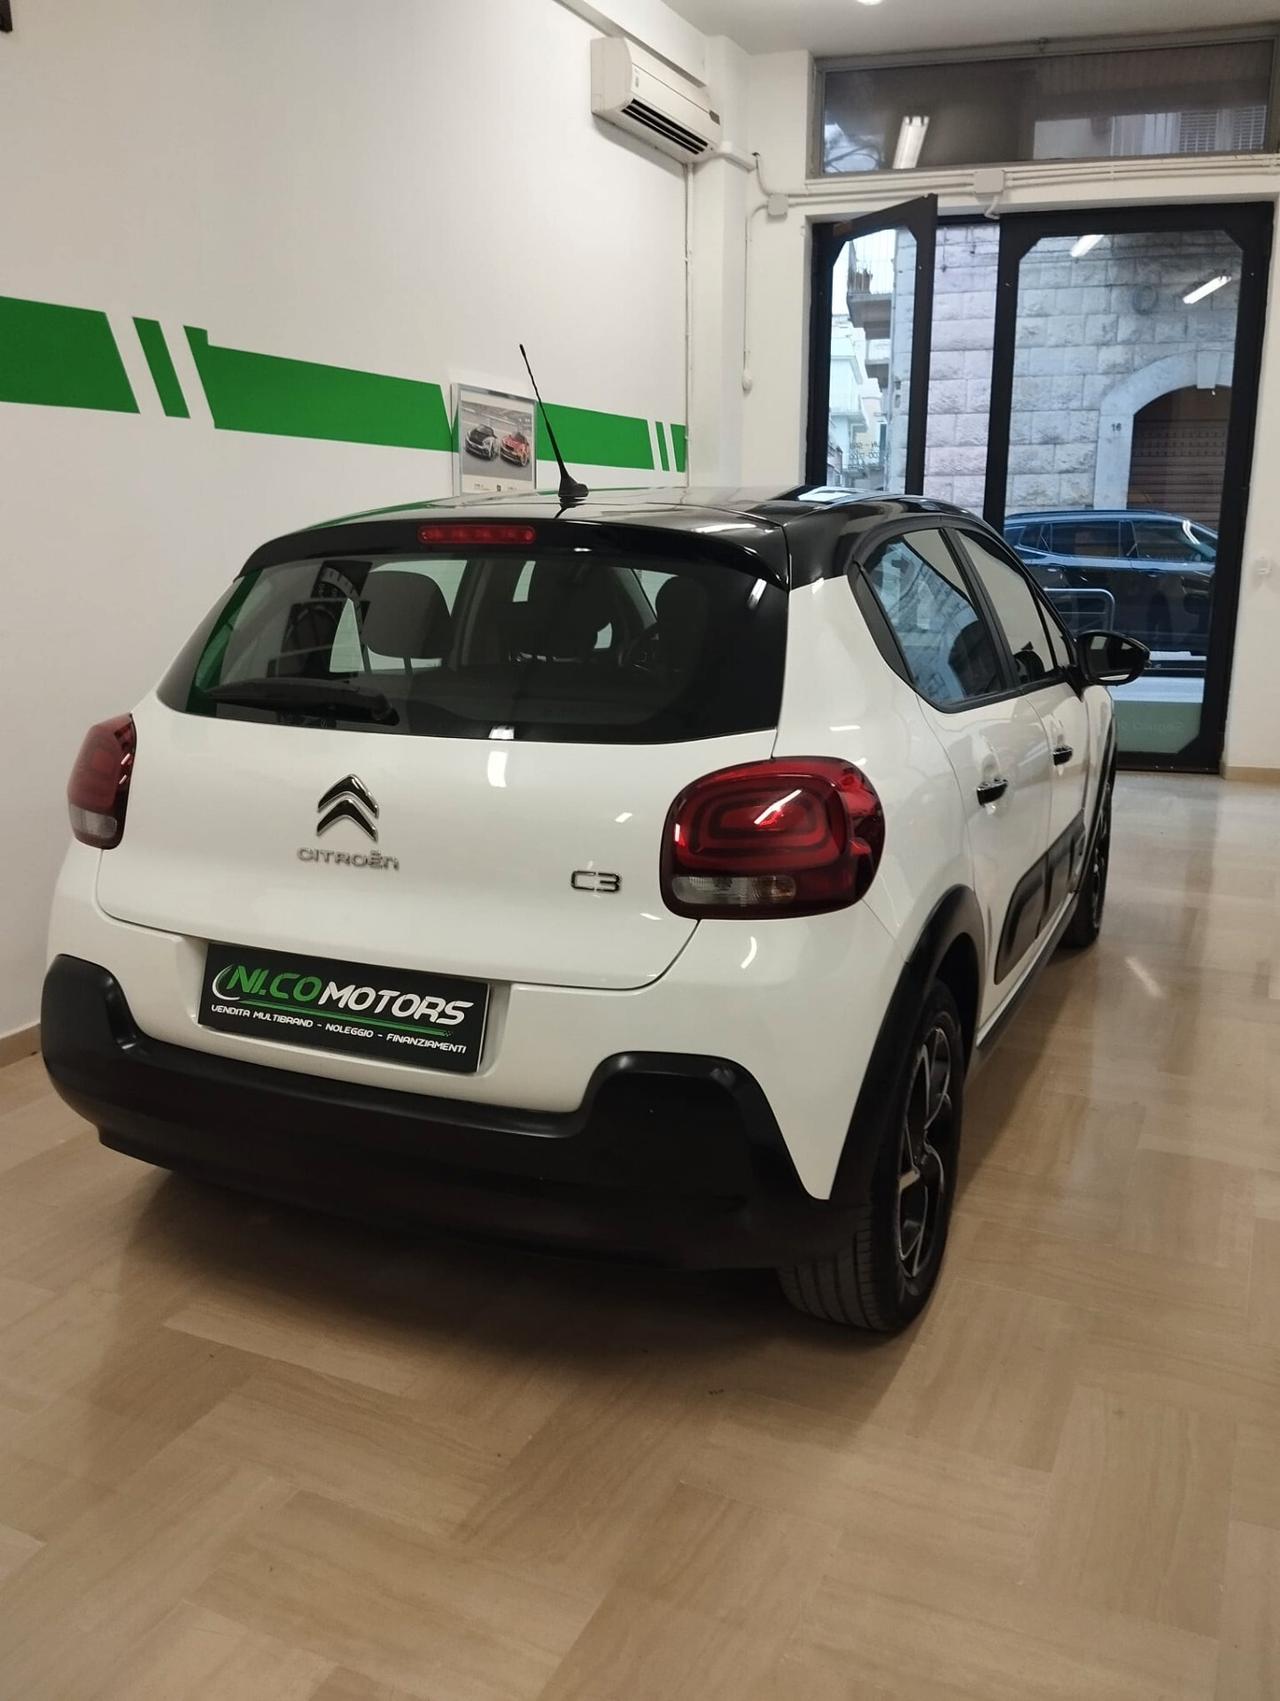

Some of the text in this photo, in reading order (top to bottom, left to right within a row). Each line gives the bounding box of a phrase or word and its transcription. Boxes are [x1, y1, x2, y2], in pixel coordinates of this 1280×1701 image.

[571, 870, 621, 893] C3
[211, 1004, 250, 1018] VENDITA
[253, 1010, 314, 1028] MULTIBRAND
[325, 1023, 374, 1038] NOLEGGIO
[386, 1033, 467, 1054] FINANZIAMENTI
